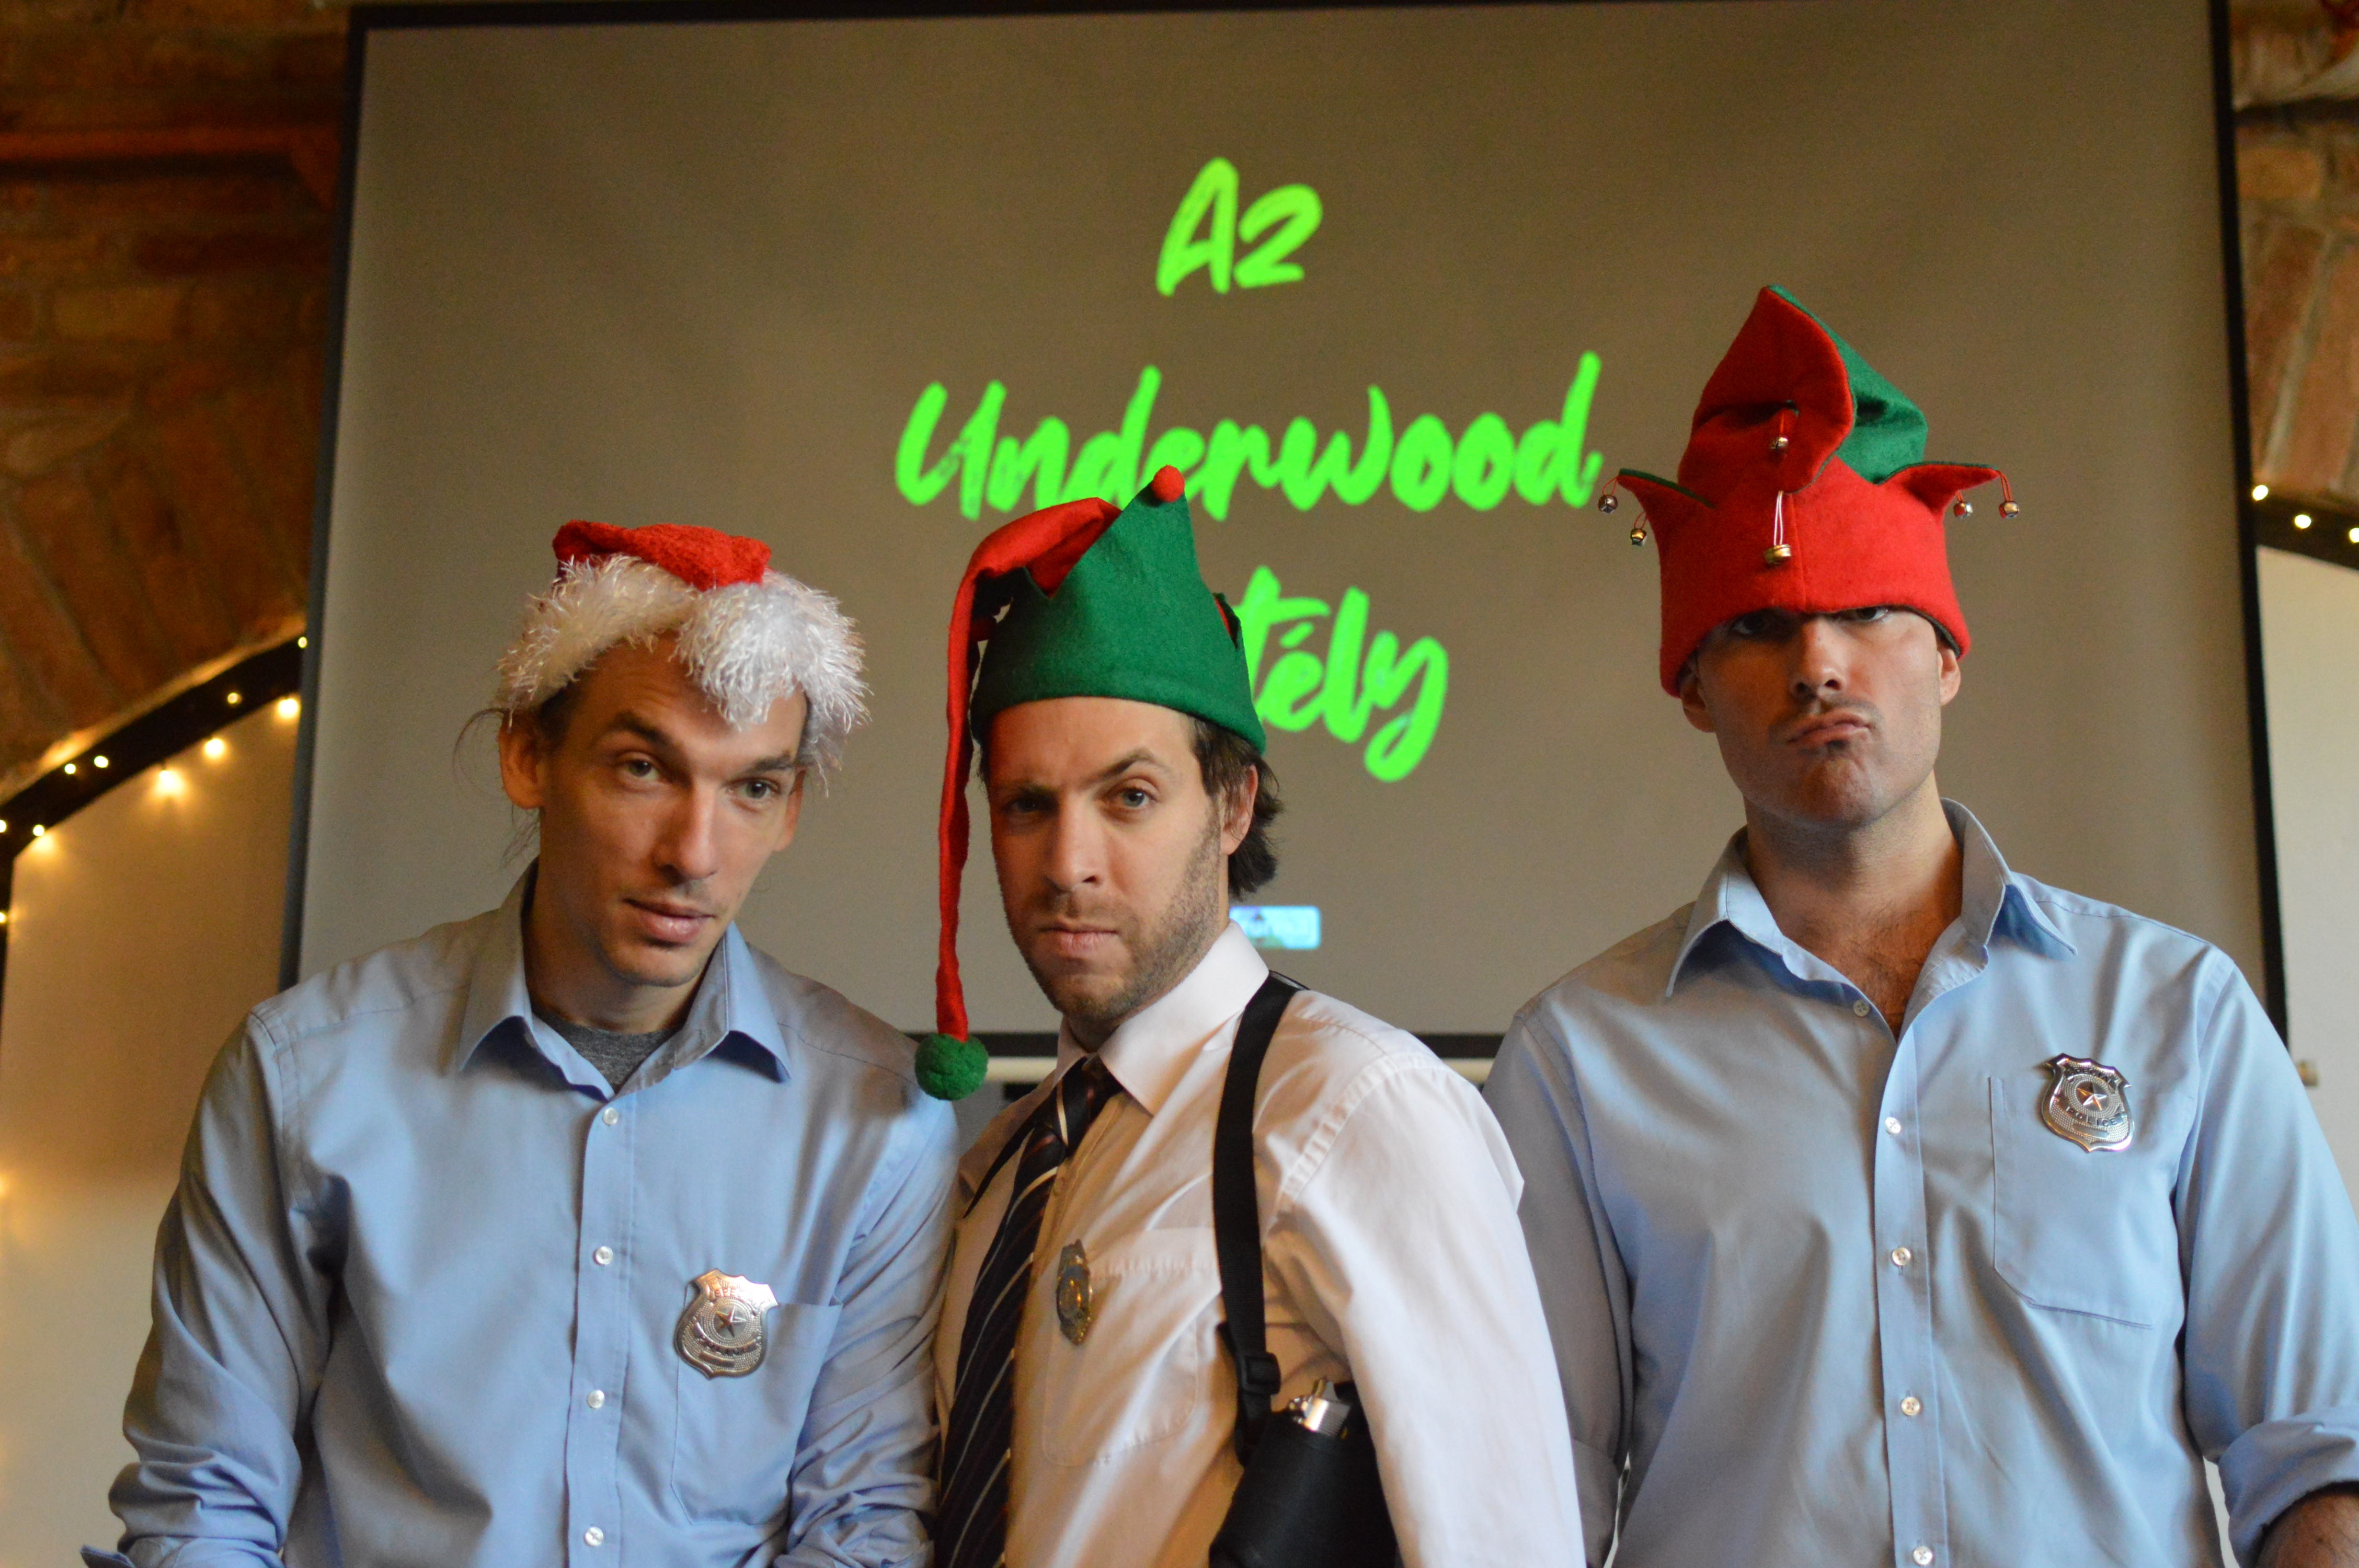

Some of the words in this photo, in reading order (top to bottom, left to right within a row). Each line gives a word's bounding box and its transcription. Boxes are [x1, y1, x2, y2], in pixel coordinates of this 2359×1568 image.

[1155, 156, 1323, 297] A2
[895, 350, 1605, 522] Underwood
[1231, 565, 1450, 783] tély
[2066, 1105, 2117, 1126] POLICE
